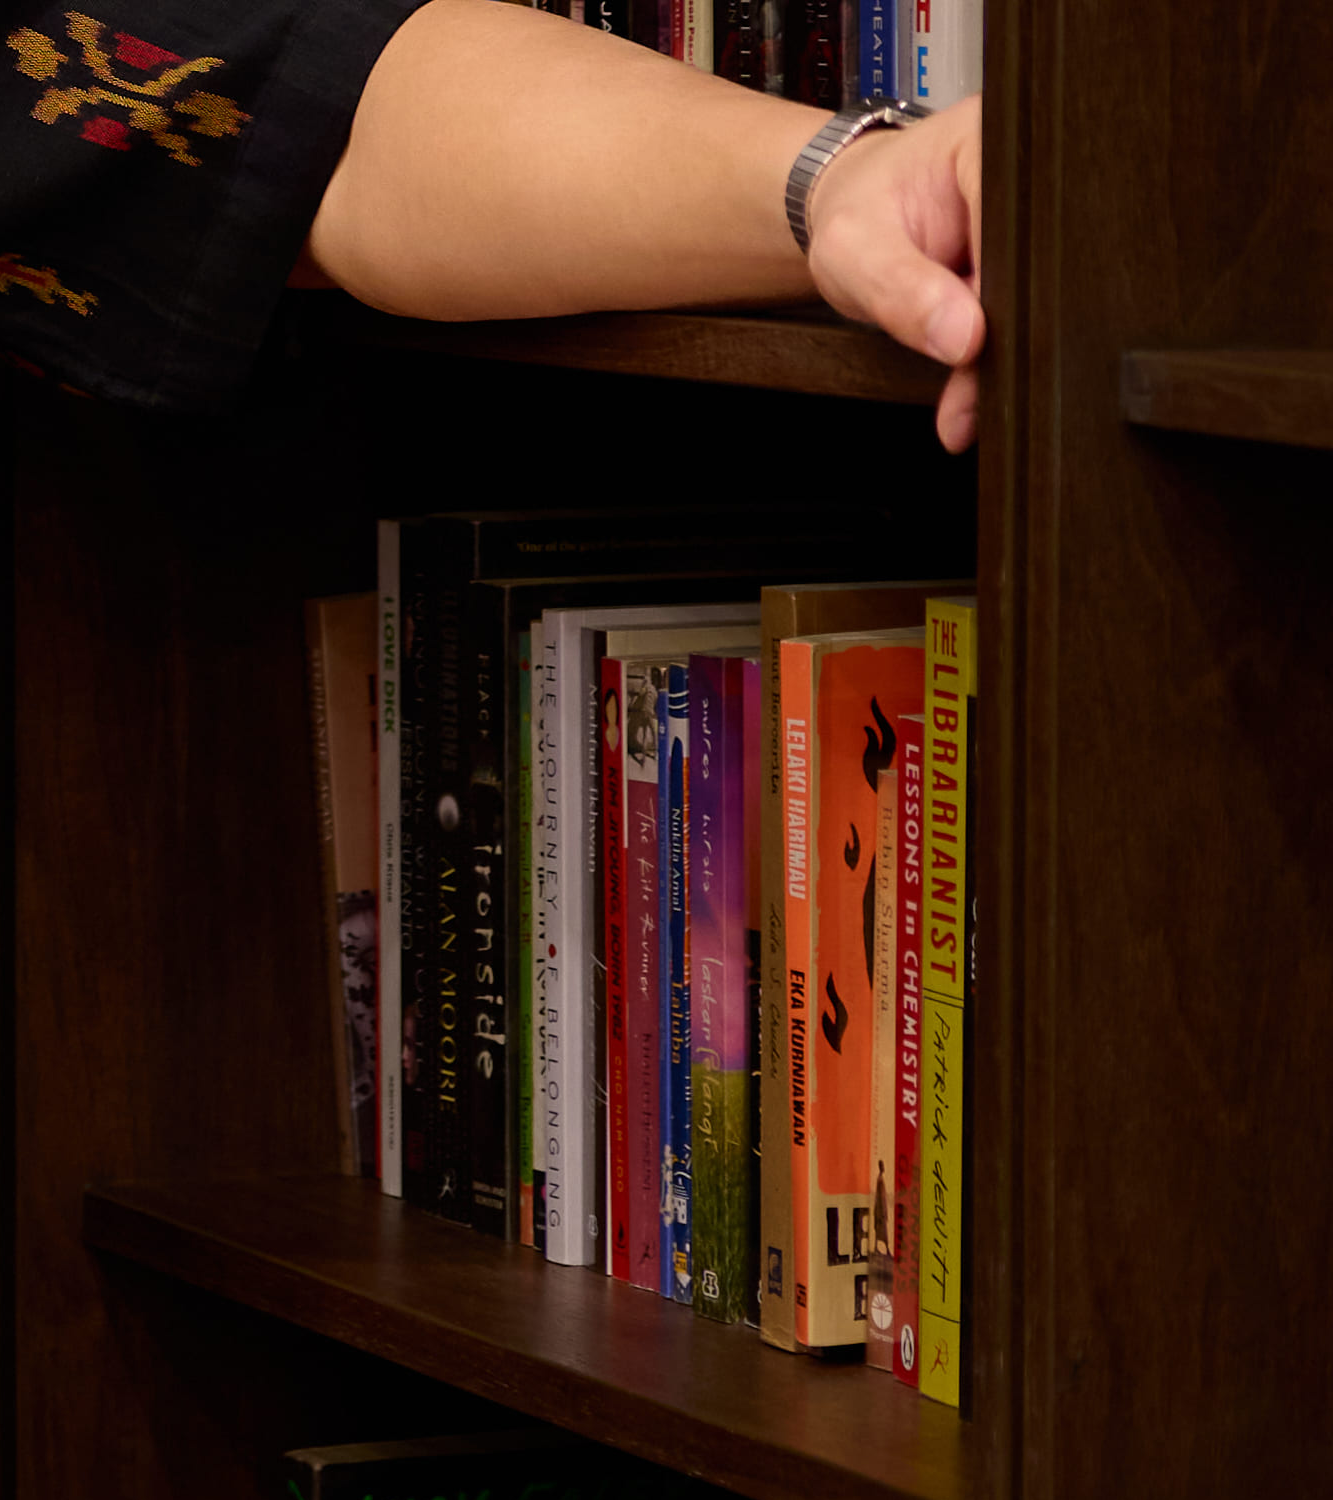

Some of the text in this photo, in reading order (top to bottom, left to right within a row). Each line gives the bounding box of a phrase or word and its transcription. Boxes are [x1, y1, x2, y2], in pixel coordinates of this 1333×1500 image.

[900, 742, 922, 884] LESSONS
[930, 660, 960, 982] LIBRARIANIST
[790, 968, 809, 1146] EKA KURNIAWAN
[900, 946, 922, 1128] CHEMISTRY
